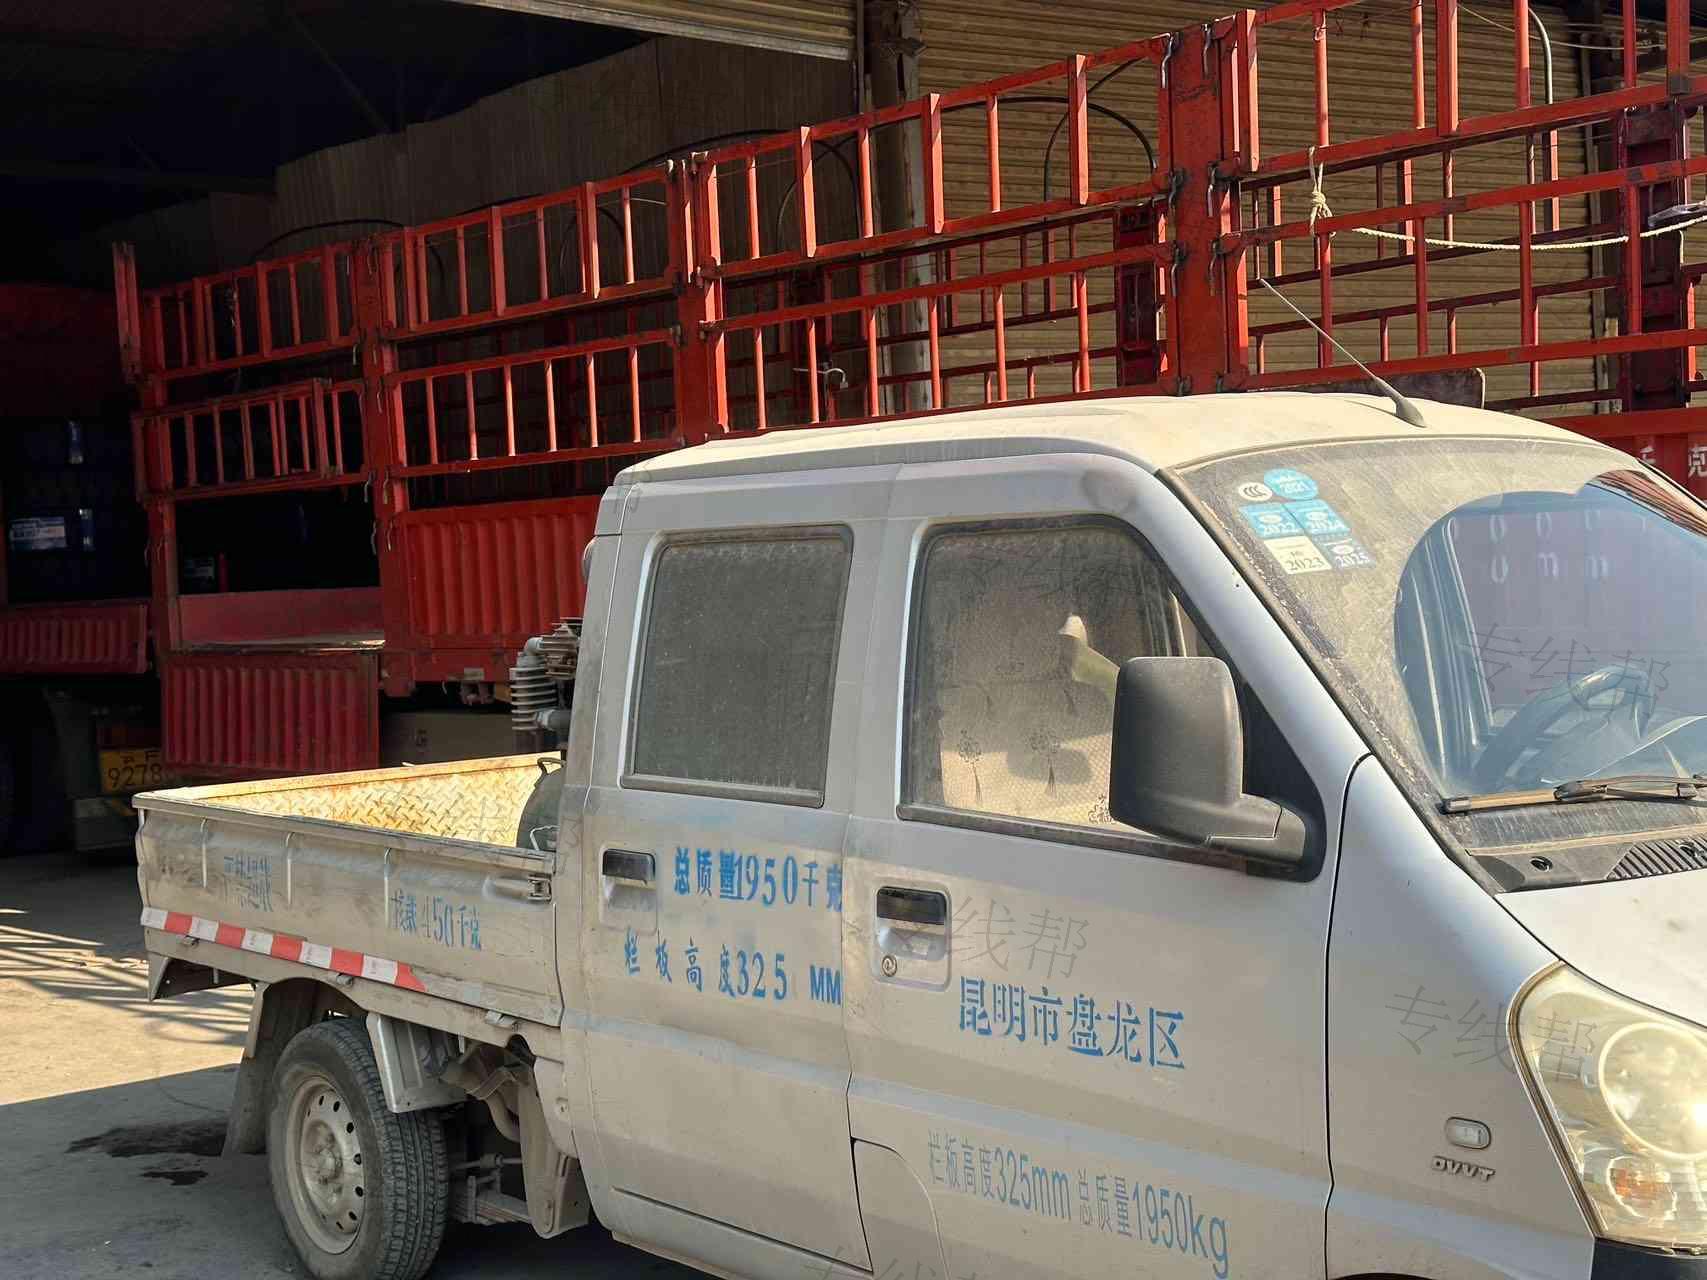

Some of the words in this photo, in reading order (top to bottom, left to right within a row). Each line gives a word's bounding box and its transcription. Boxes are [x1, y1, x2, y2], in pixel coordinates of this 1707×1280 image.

[1284, 555, 1327, 572] 2023
[959, 975, 1185, 1070] 昆明市盘龙区
